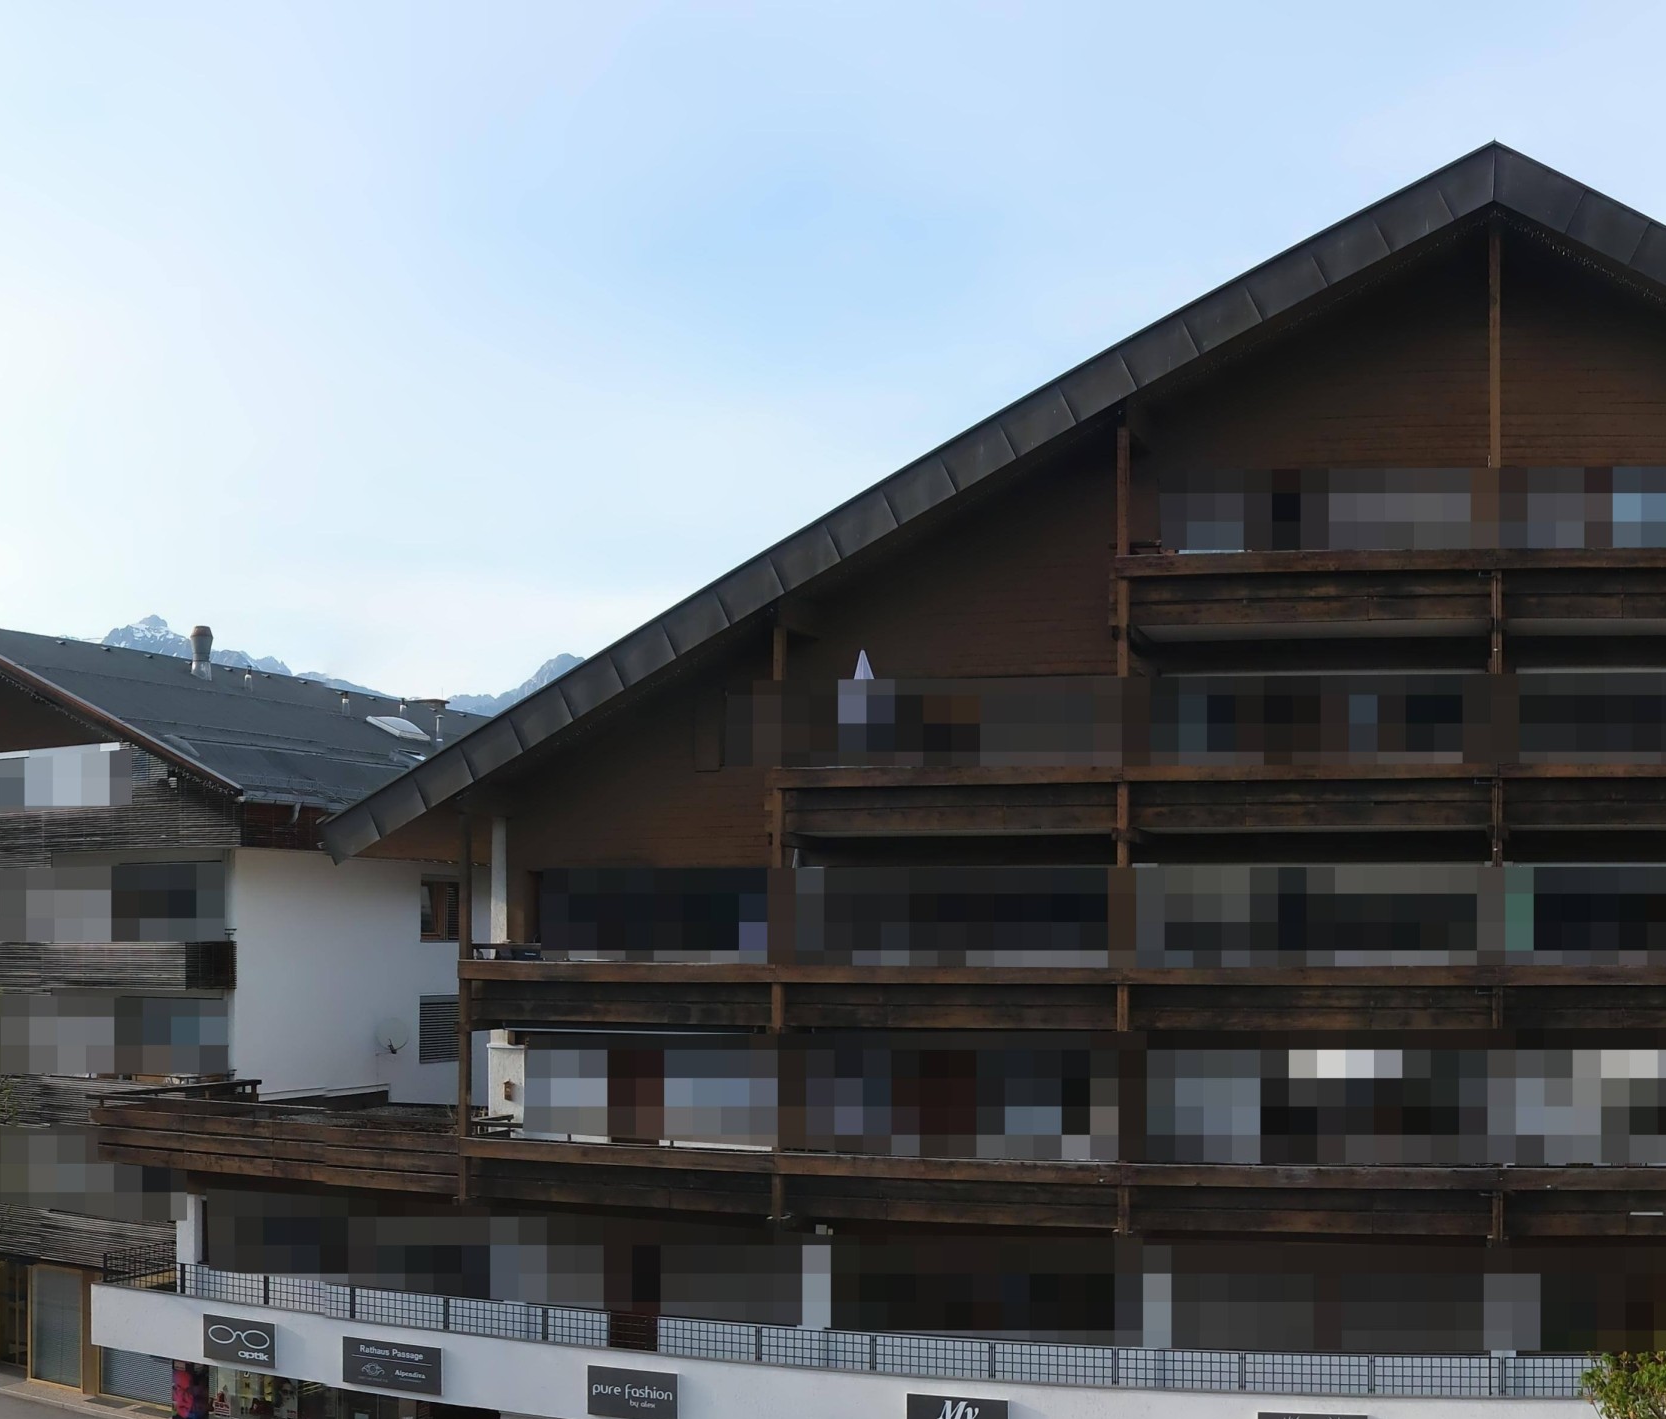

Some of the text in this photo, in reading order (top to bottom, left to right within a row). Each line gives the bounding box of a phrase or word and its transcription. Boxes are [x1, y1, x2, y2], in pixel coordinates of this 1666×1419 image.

[238, 1350, 269, 1362] optik
[359, 1344, 424, 1361] Rathaus Passage
[592, 1383, 673, 1401] pure fashion
[630, 1400, 639, 1408] by
